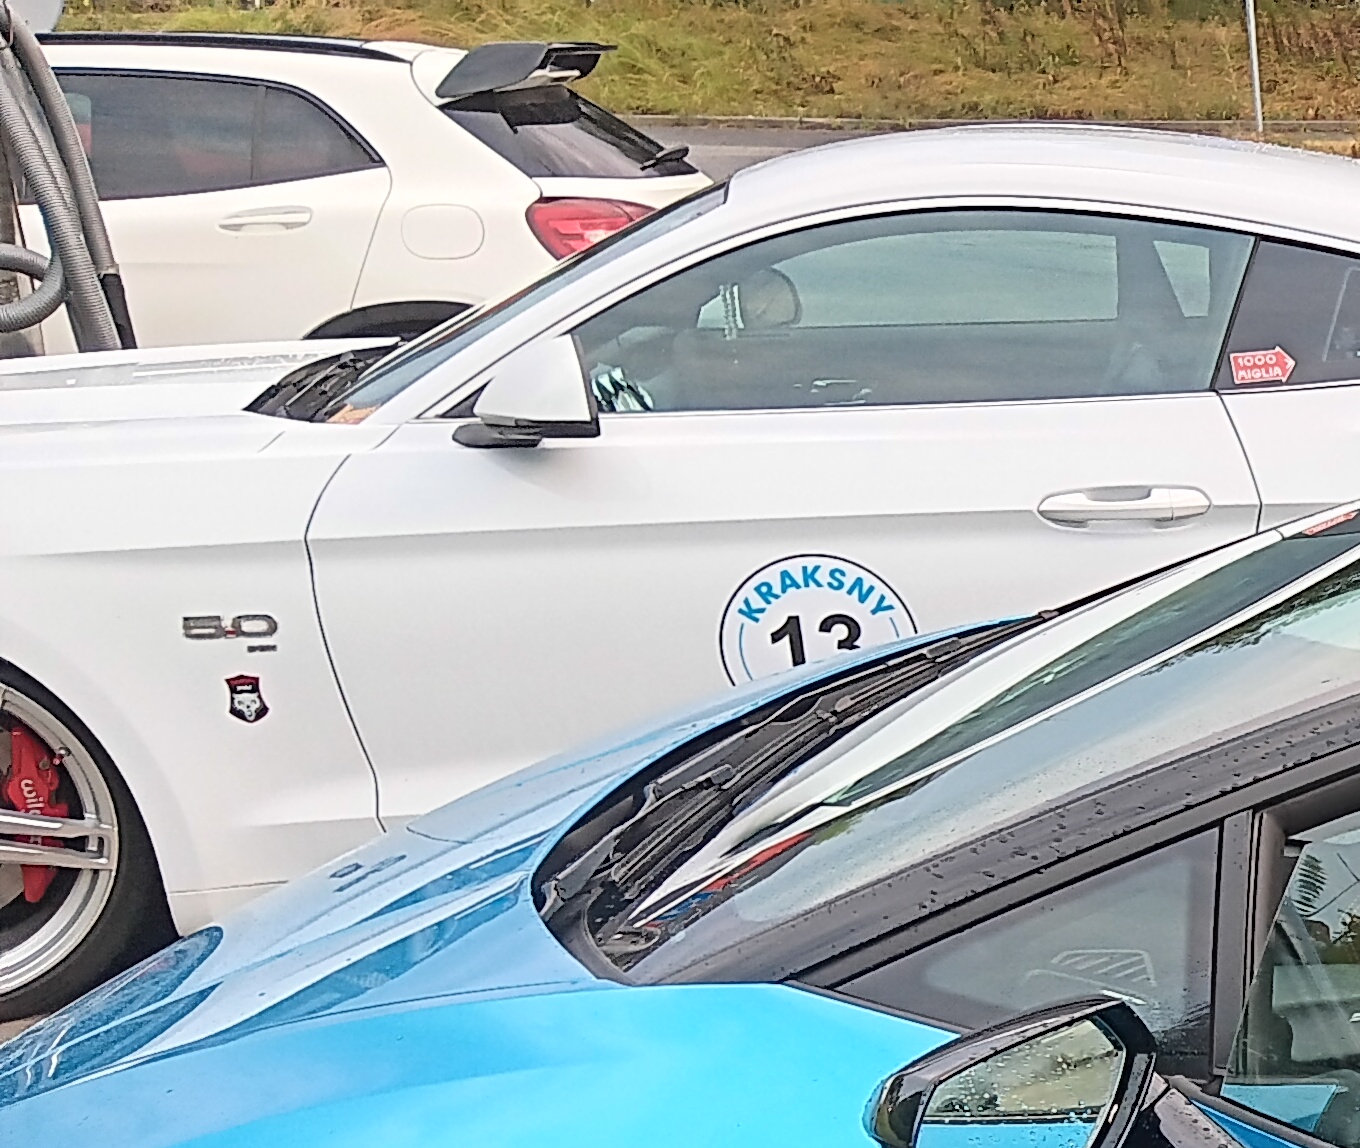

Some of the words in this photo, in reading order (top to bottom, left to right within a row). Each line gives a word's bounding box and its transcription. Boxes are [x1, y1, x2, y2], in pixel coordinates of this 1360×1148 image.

[1237, 354, 1278, 368] 1000
[1237, 366, 1283, 381] MIGLIA
[737, 565, 896, 624] KRAKSNY
[182, 614, 278, 639] 5.0
